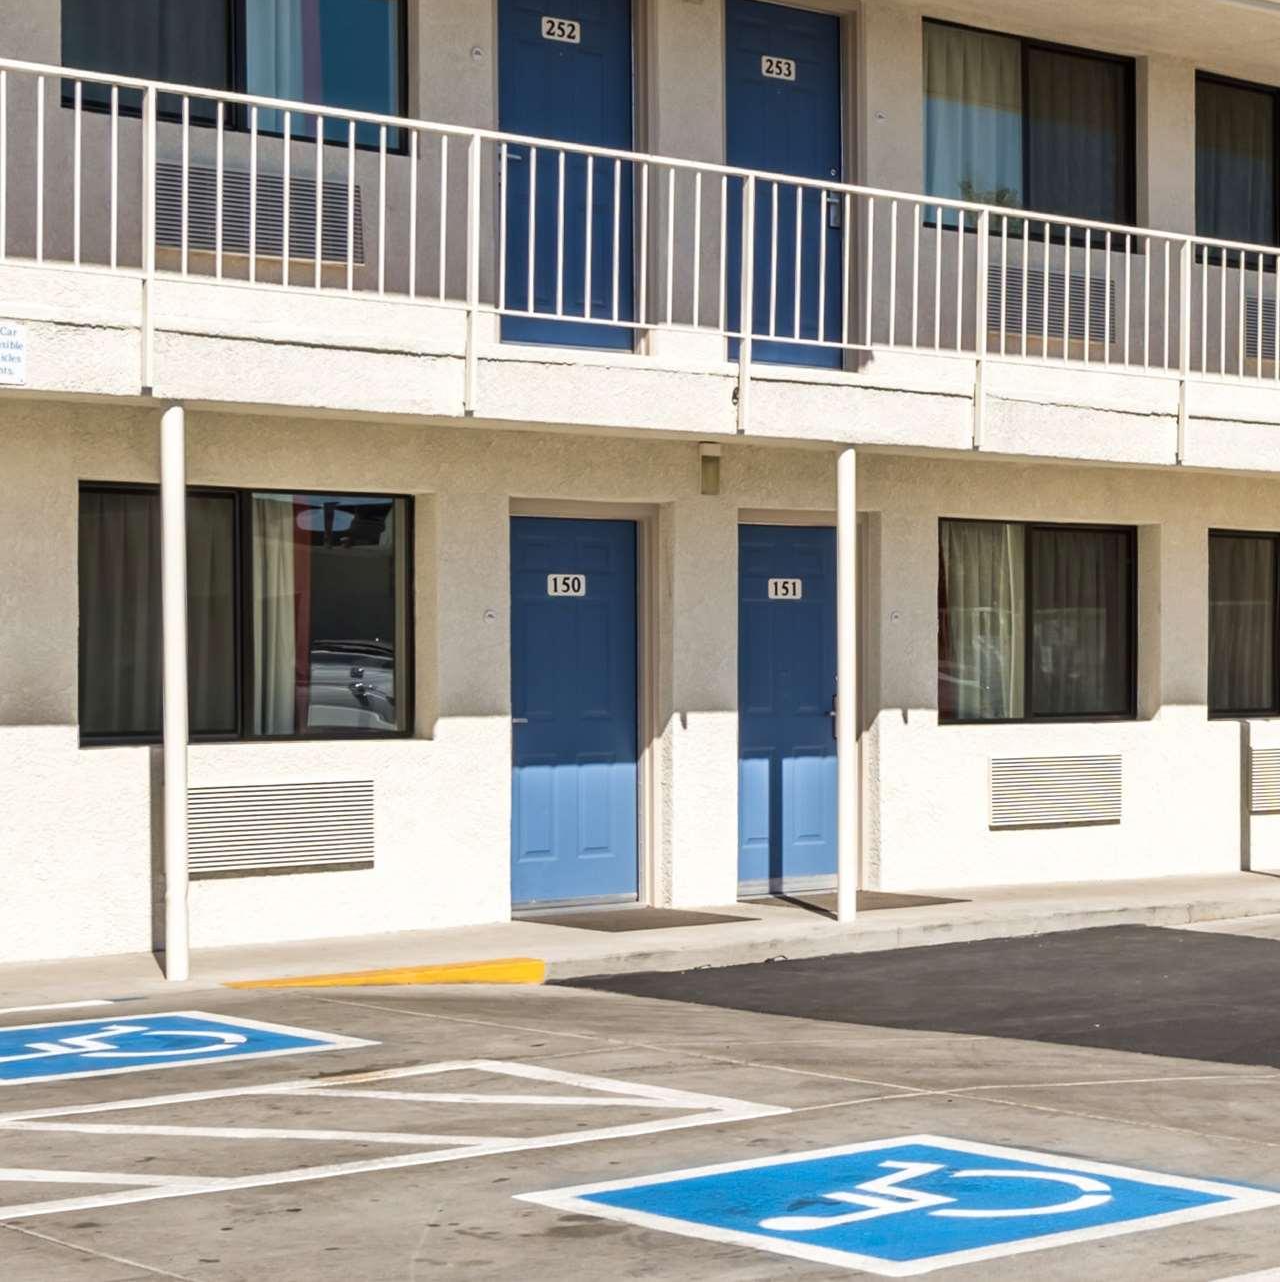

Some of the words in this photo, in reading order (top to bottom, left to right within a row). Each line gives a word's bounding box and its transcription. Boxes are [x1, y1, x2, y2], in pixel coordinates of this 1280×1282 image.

[546, 19, 577, 40] 252
[765, 58, 792, 78] 253
[552, 576, 581, 593] 150
[773, 581, 797, 596] 151
